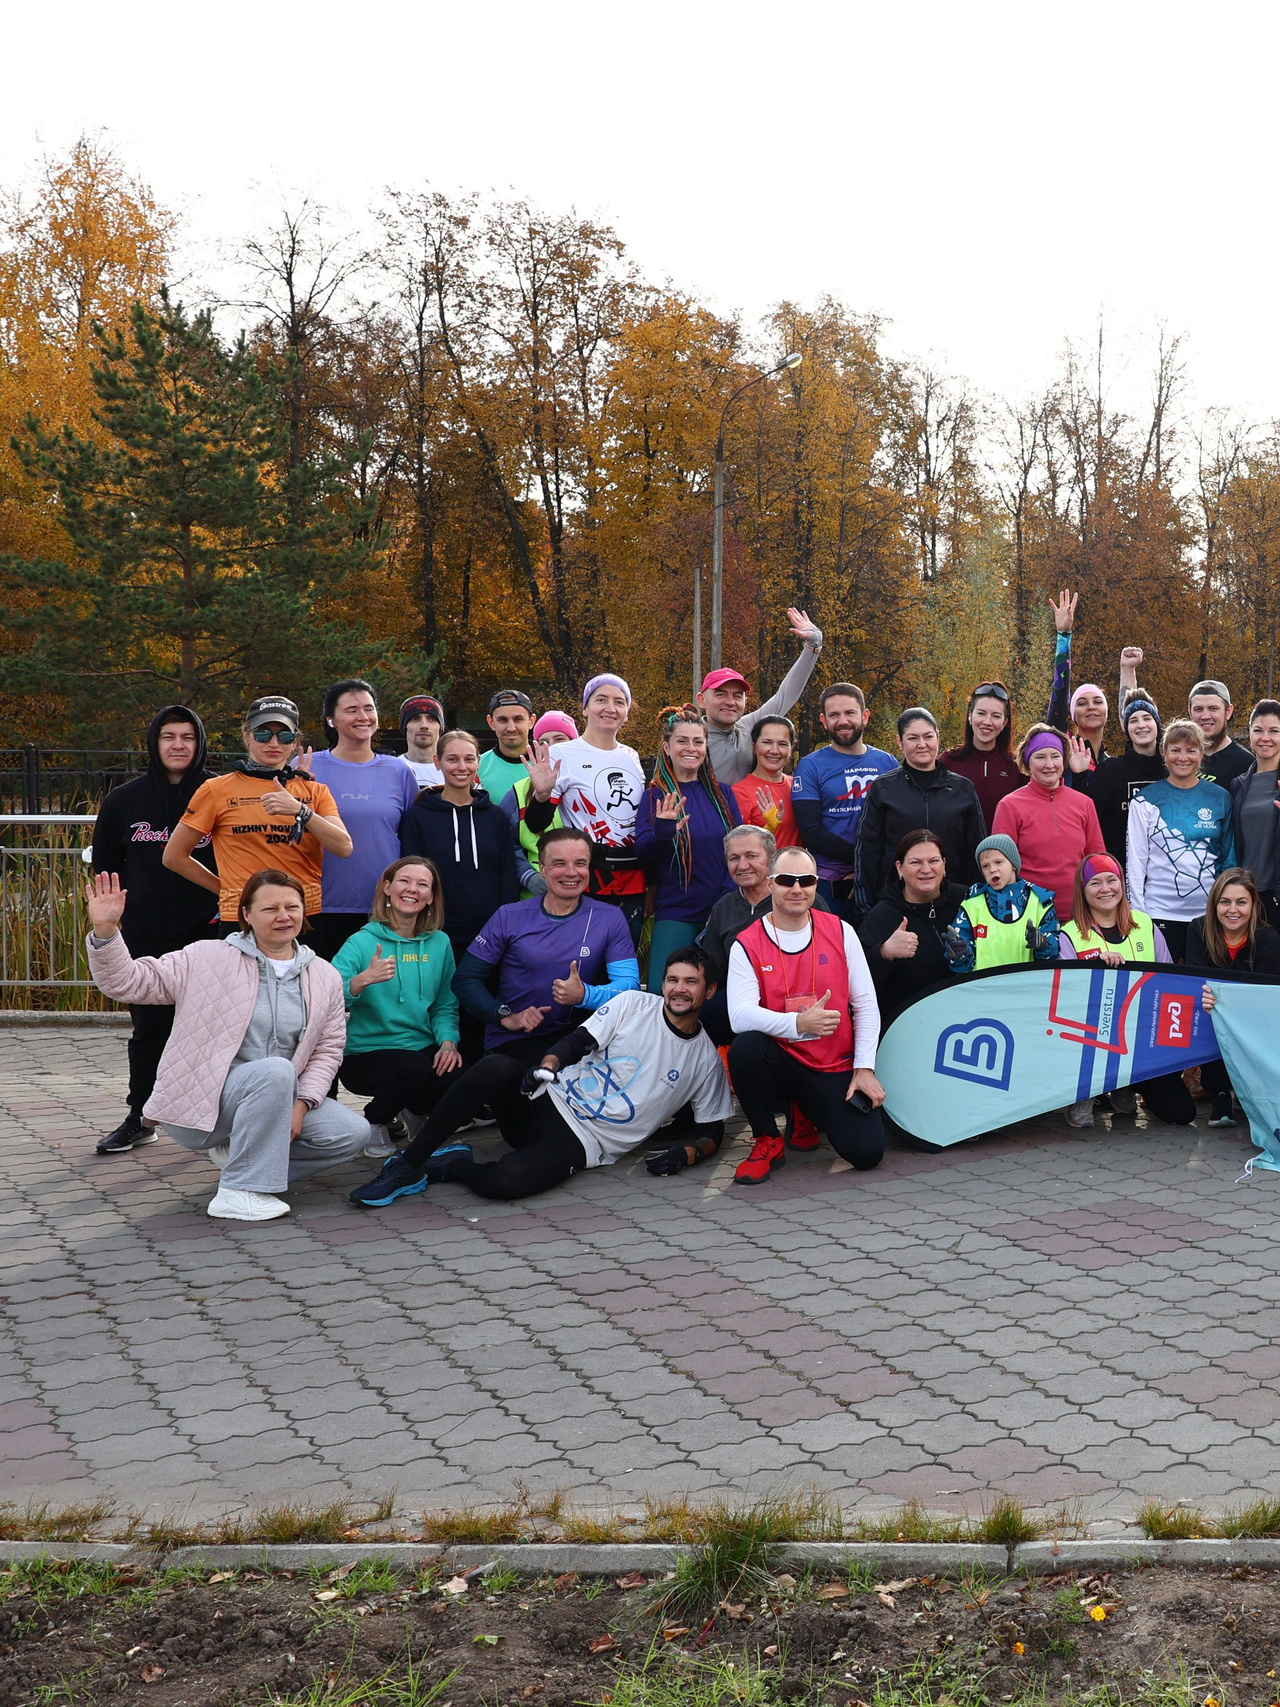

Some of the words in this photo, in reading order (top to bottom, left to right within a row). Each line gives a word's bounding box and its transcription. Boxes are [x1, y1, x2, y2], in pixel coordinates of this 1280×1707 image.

[232, 825, 268, 834] NIZHNY
[265, 834, 289, 844] 202
[1099, 988, 1114, 1037] 5verst.ru
[1149, 1011, 1158, 1048] ОФИЦИАЛЬНЫЙ
